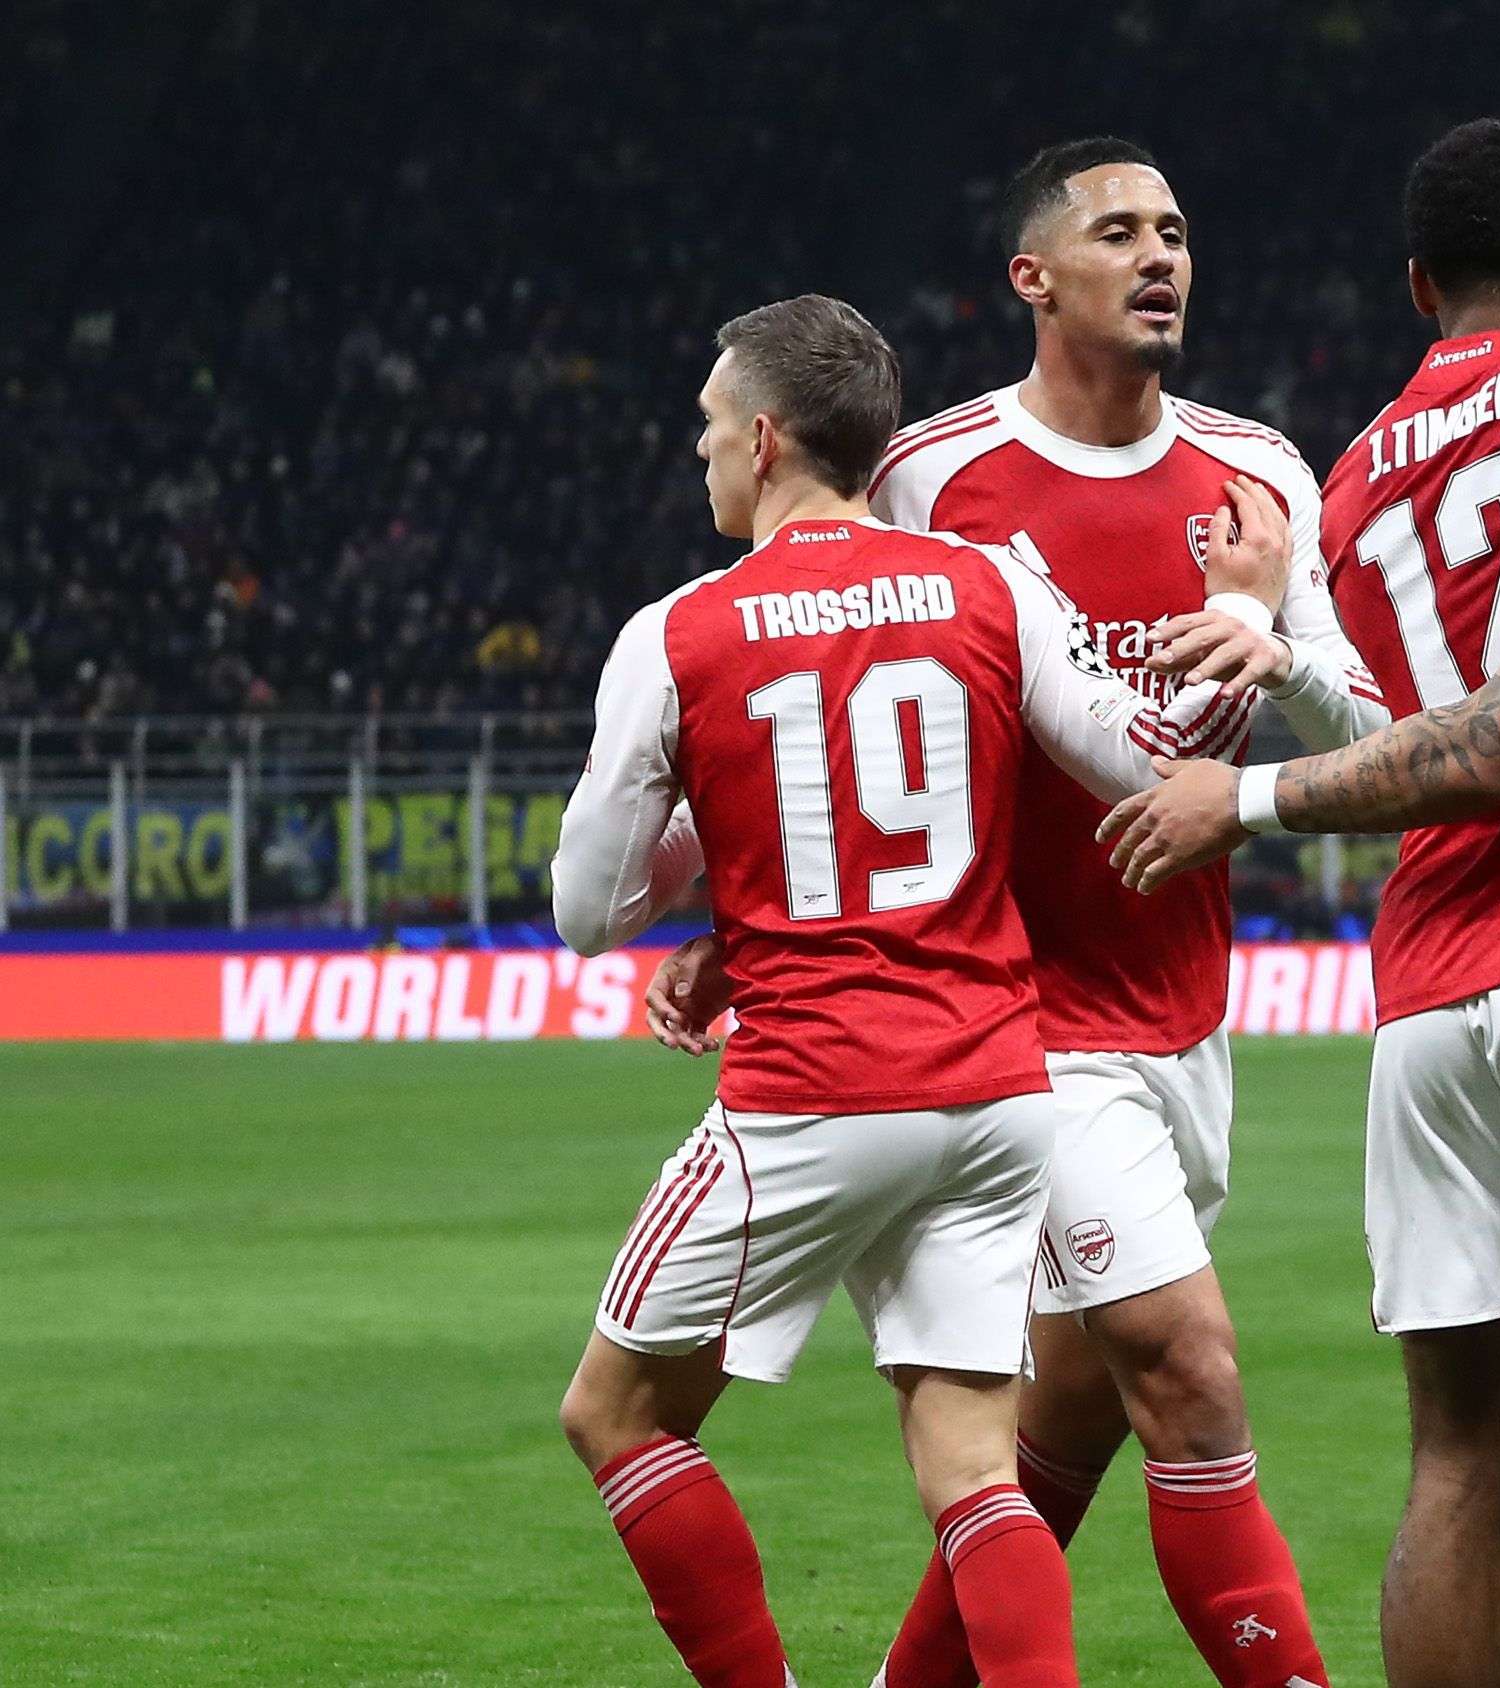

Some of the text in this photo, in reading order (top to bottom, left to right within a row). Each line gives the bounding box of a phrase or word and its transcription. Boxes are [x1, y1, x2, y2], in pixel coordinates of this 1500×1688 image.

[1429, 340, 1494, 369] Arsenal
[788, 526, 851, 545] Arsenal
[733, 573, 956, 642] TROSSARD
[747, 656, 976, 921] 19
[219, 954, 638, 1043] WORLD'S
